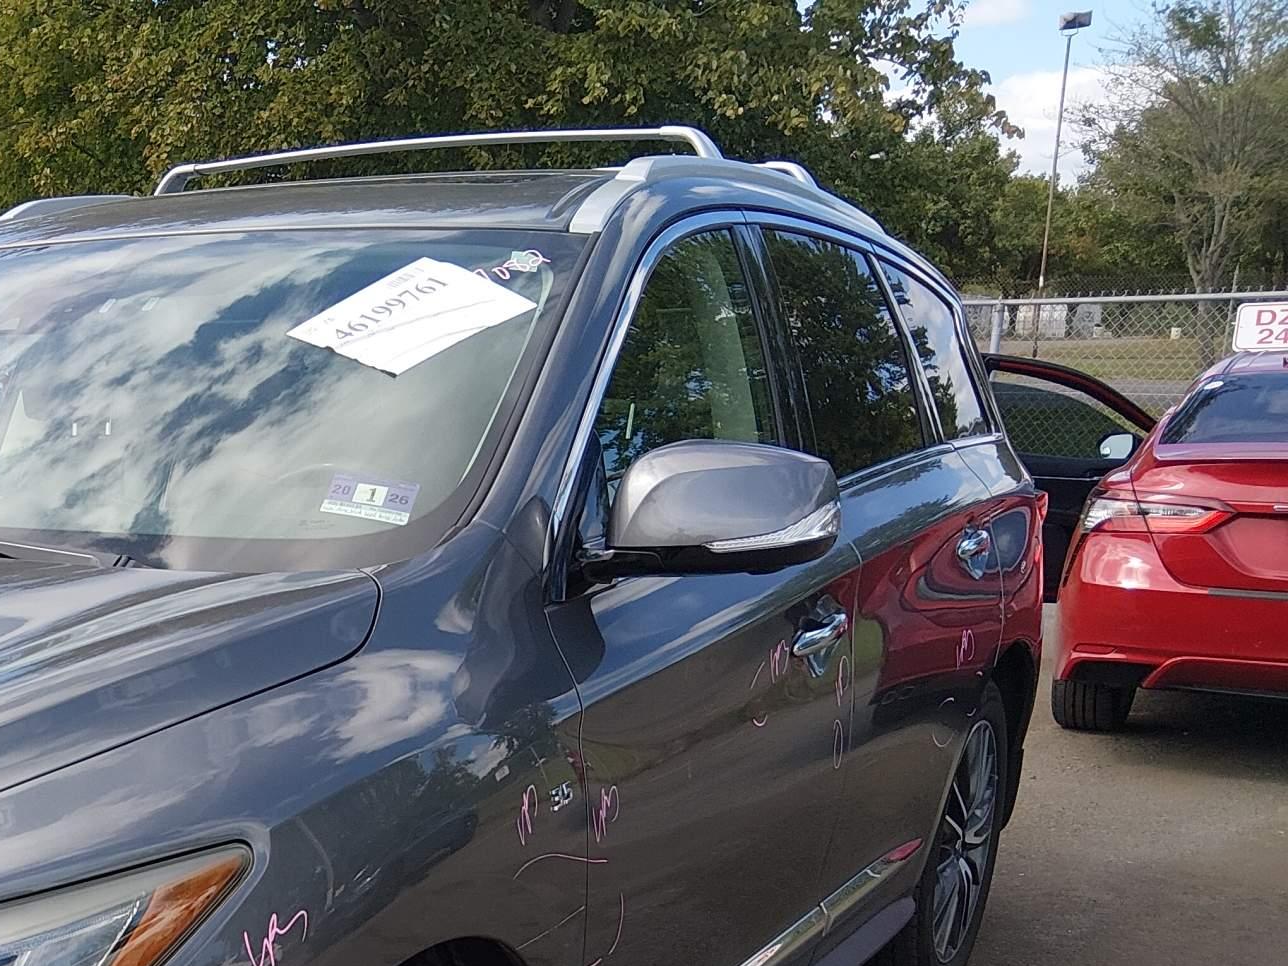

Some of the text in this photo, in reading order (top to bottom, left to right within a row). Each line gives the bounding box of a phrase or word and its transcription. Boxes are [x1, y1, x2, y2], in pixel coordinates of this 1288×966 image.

[335, 277, 449, 342] 46199761
[1256, 328, 1288, 344] 24
[332, 484, 409, 505] 20 1 26
